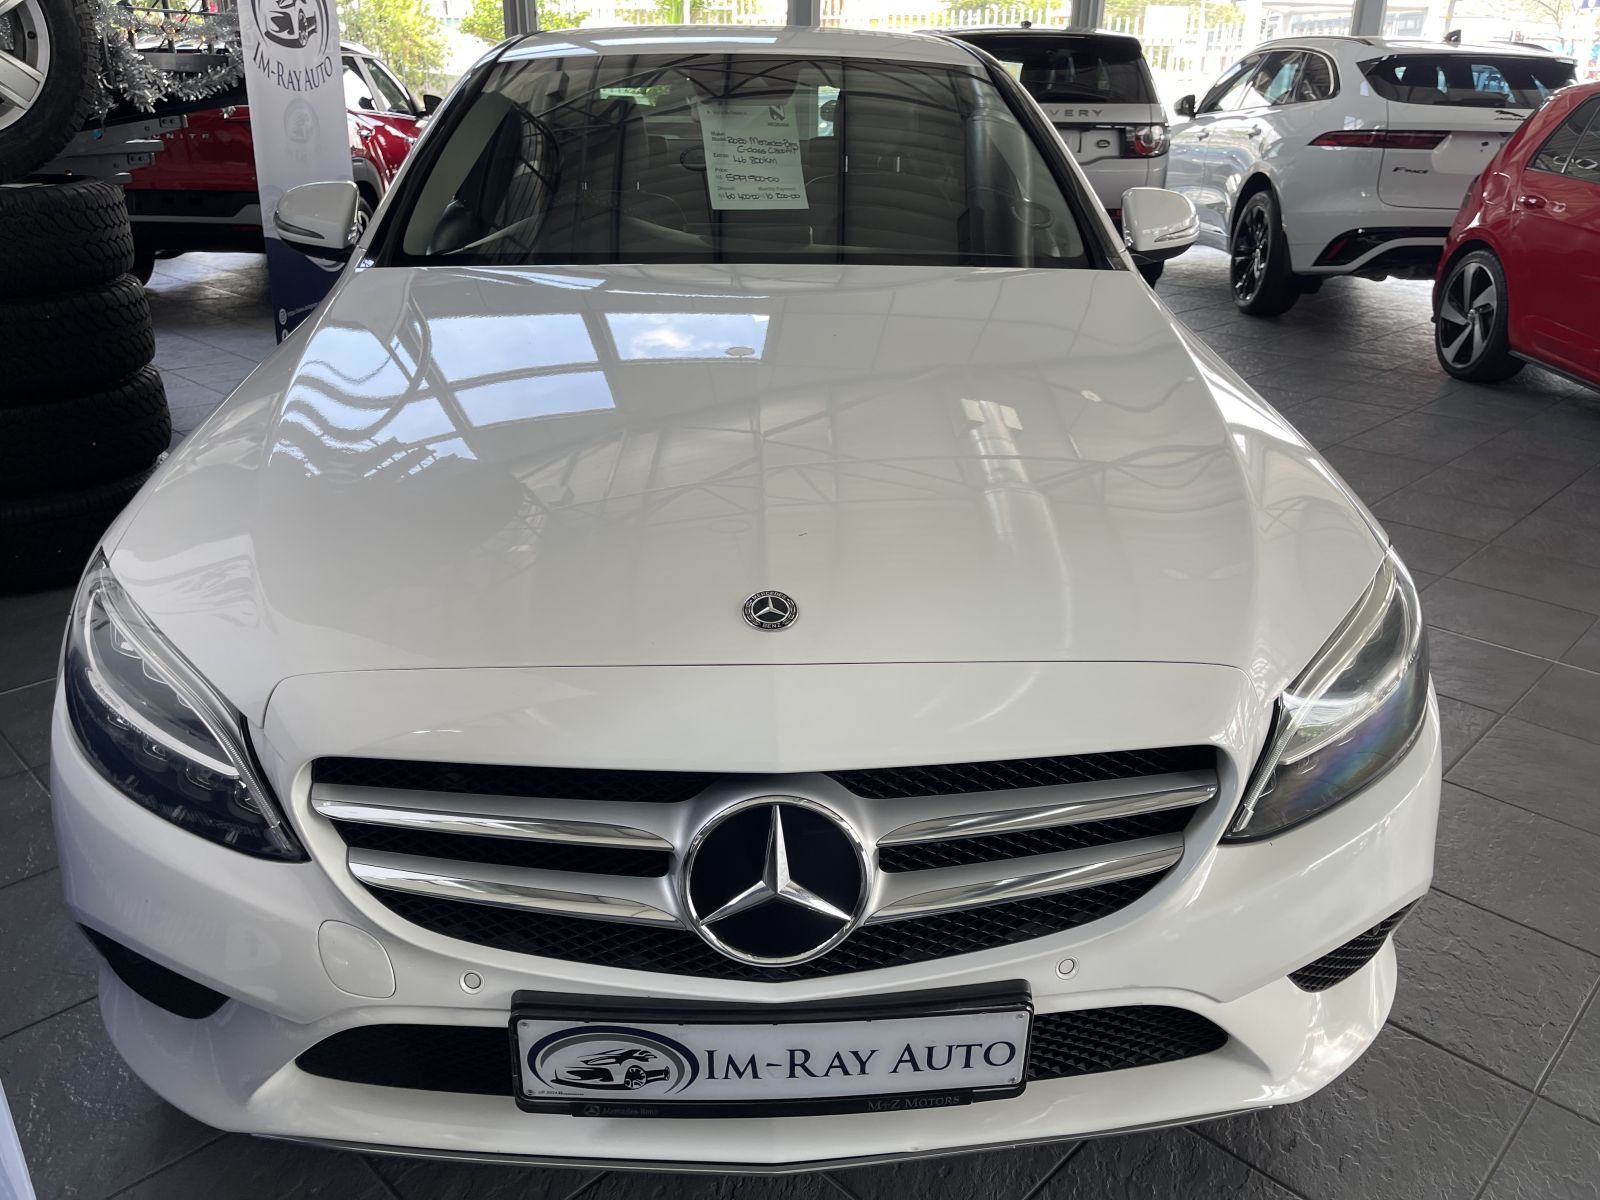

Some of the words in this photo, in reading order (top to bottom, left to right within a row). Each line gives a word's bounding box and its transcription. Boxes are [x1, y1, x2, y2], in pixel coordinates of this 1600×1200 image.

[253, 41, 302, 92] IM-RAY
[304, 56, 333, 92] AUTO
[705, 1048, 879, 1080] IM-RAY
[889, 1041, 1017, 1074] AUTO
[904, 1095, 960, 1109] MOTORS
